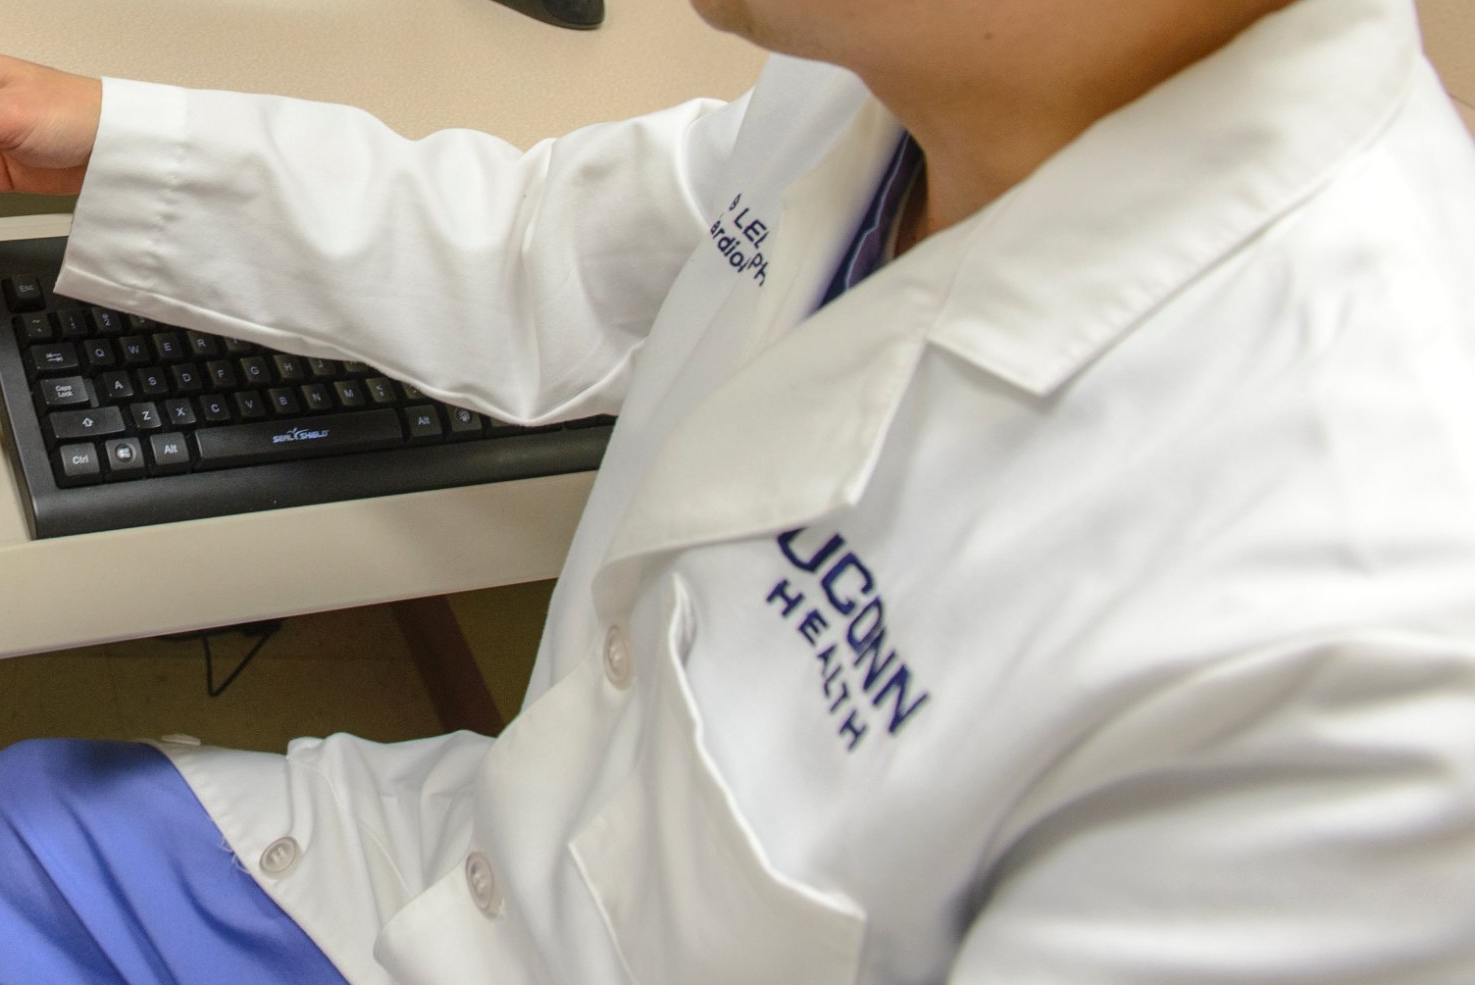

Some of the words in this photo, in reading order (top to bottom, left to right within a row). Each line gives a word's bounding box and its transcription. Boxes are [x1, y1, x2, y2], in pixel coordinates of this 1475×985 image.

[163, 342, 172, 352] E
[197, 338, 207, 348] R
[94, 347, 105, 358] Q
[128, 344, 139, 354] W
[250, 366, 260, 376] G
[284, 362, 294, 371] H
[182, 373, 191, 382] D
[218, 369, 226, 379] F
[114, 380, 124, 390] A
[148, 376, 157, 386] S
[312, 392, 322, 402] N
[344, 389, 354, 399] M
[245, 400, 254, 409] V
[278, 396, 288, 406] B
[176, 407, 186, 416] X
[210, 403, 220, 413] C
[142, 411, 152, 420] Z
[417, 416, 430, 425] Alt
[273, 434, 295, 443] SEAL
[298, 430, 330, 440] SHIELD
[164, 444, 178, 454] Alt
[72, 455, 89, 465] Ctrl
[776, 526, 931, 735] UCONN
[765, 579, 867, 753] HEALTH
